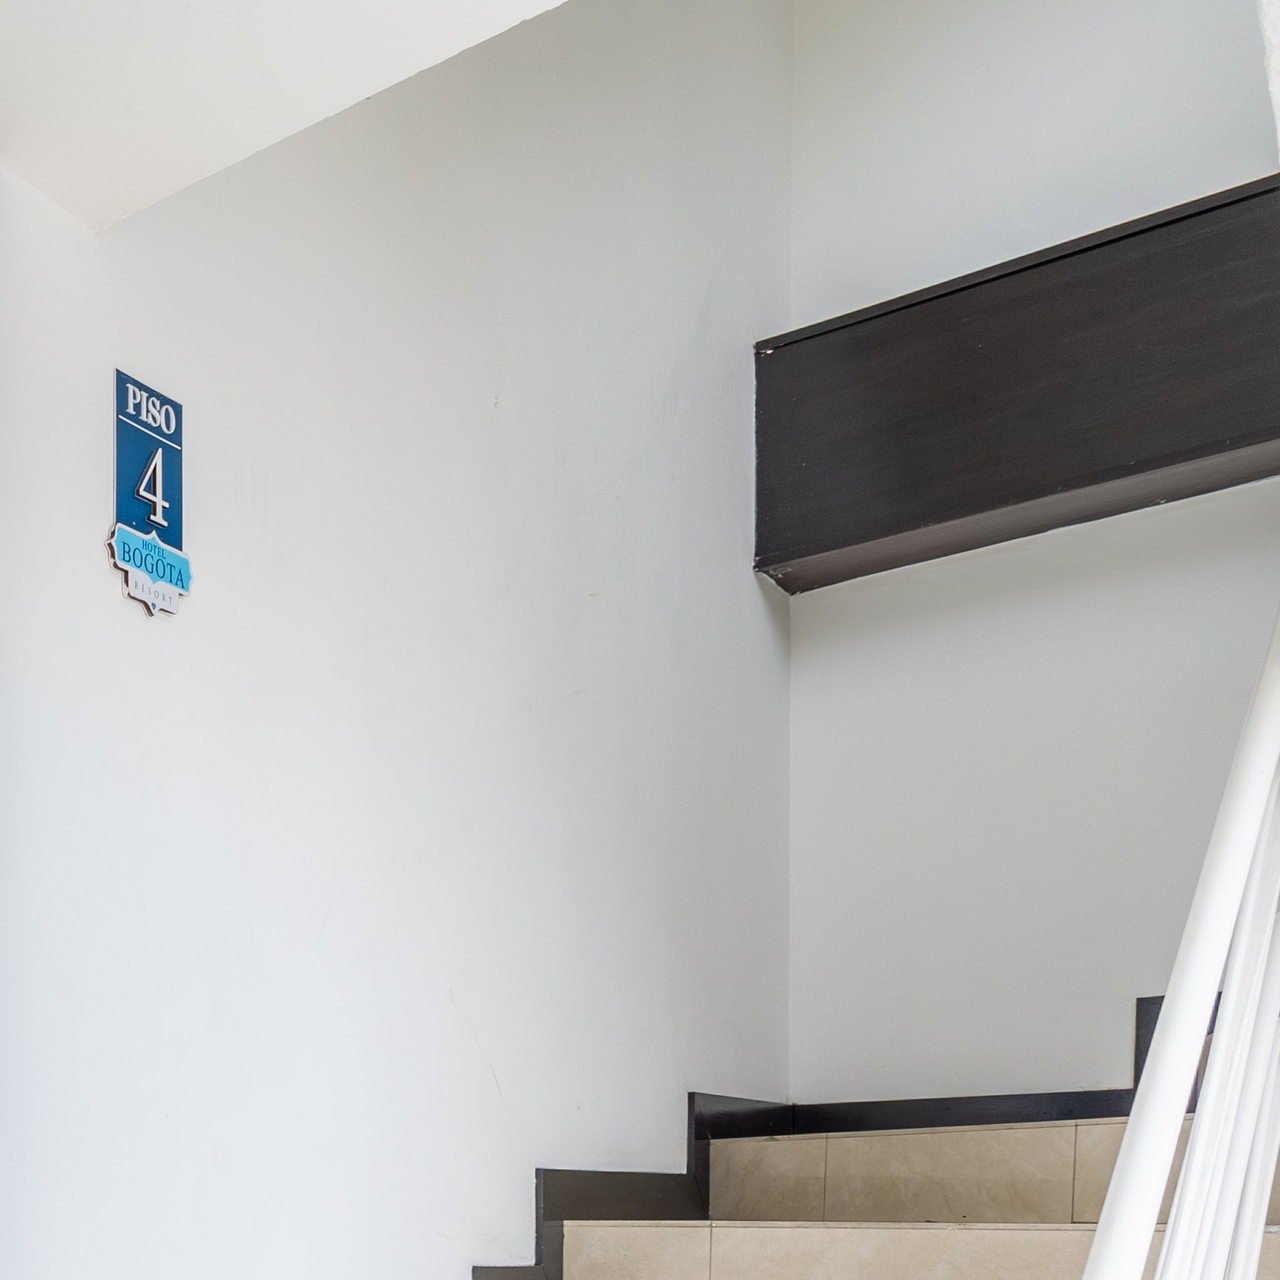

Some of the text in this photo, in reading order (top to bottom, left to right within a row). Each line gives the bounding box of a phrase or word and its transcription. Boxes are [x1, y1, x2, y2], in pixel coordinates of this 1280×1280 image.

[125, 382, 177, 435] PISO
[134, 447, 170, 528] 4
[121, 541, 186, 589] BOGOTA
[142, 539, 167, 560] HOTEL
[134, 580, 174, 606] RESORT
